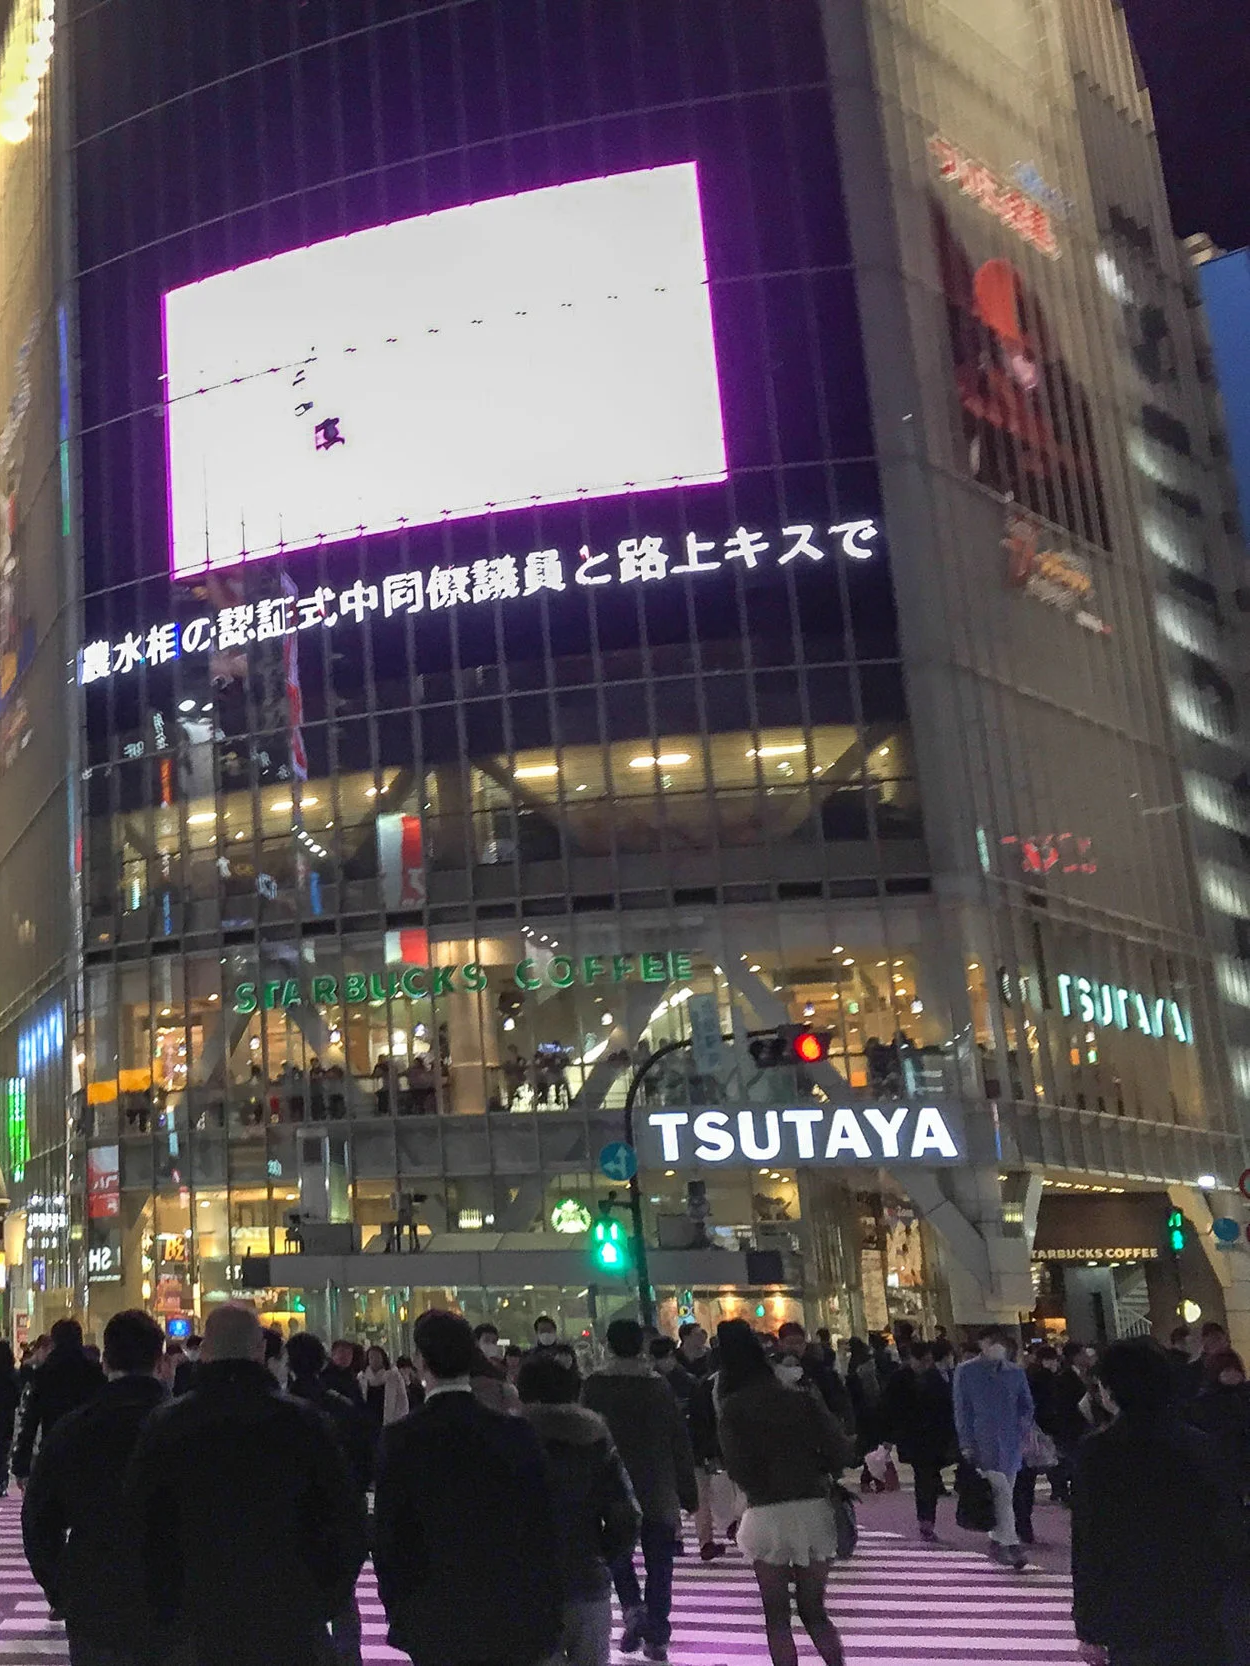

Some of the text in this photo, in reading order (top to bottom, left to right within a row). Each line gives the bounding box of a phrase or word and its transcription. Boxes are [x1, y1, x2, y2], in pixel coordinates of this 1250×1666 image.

[234, 951, 695, 1014] STARBUCKS COFFEE
[1057, 972, 1194, 1046] TSUTAYA
[648, 1106, 959, 1162] TSUTAYA
[1105, 1247, 1158, 1259] COFFEE
